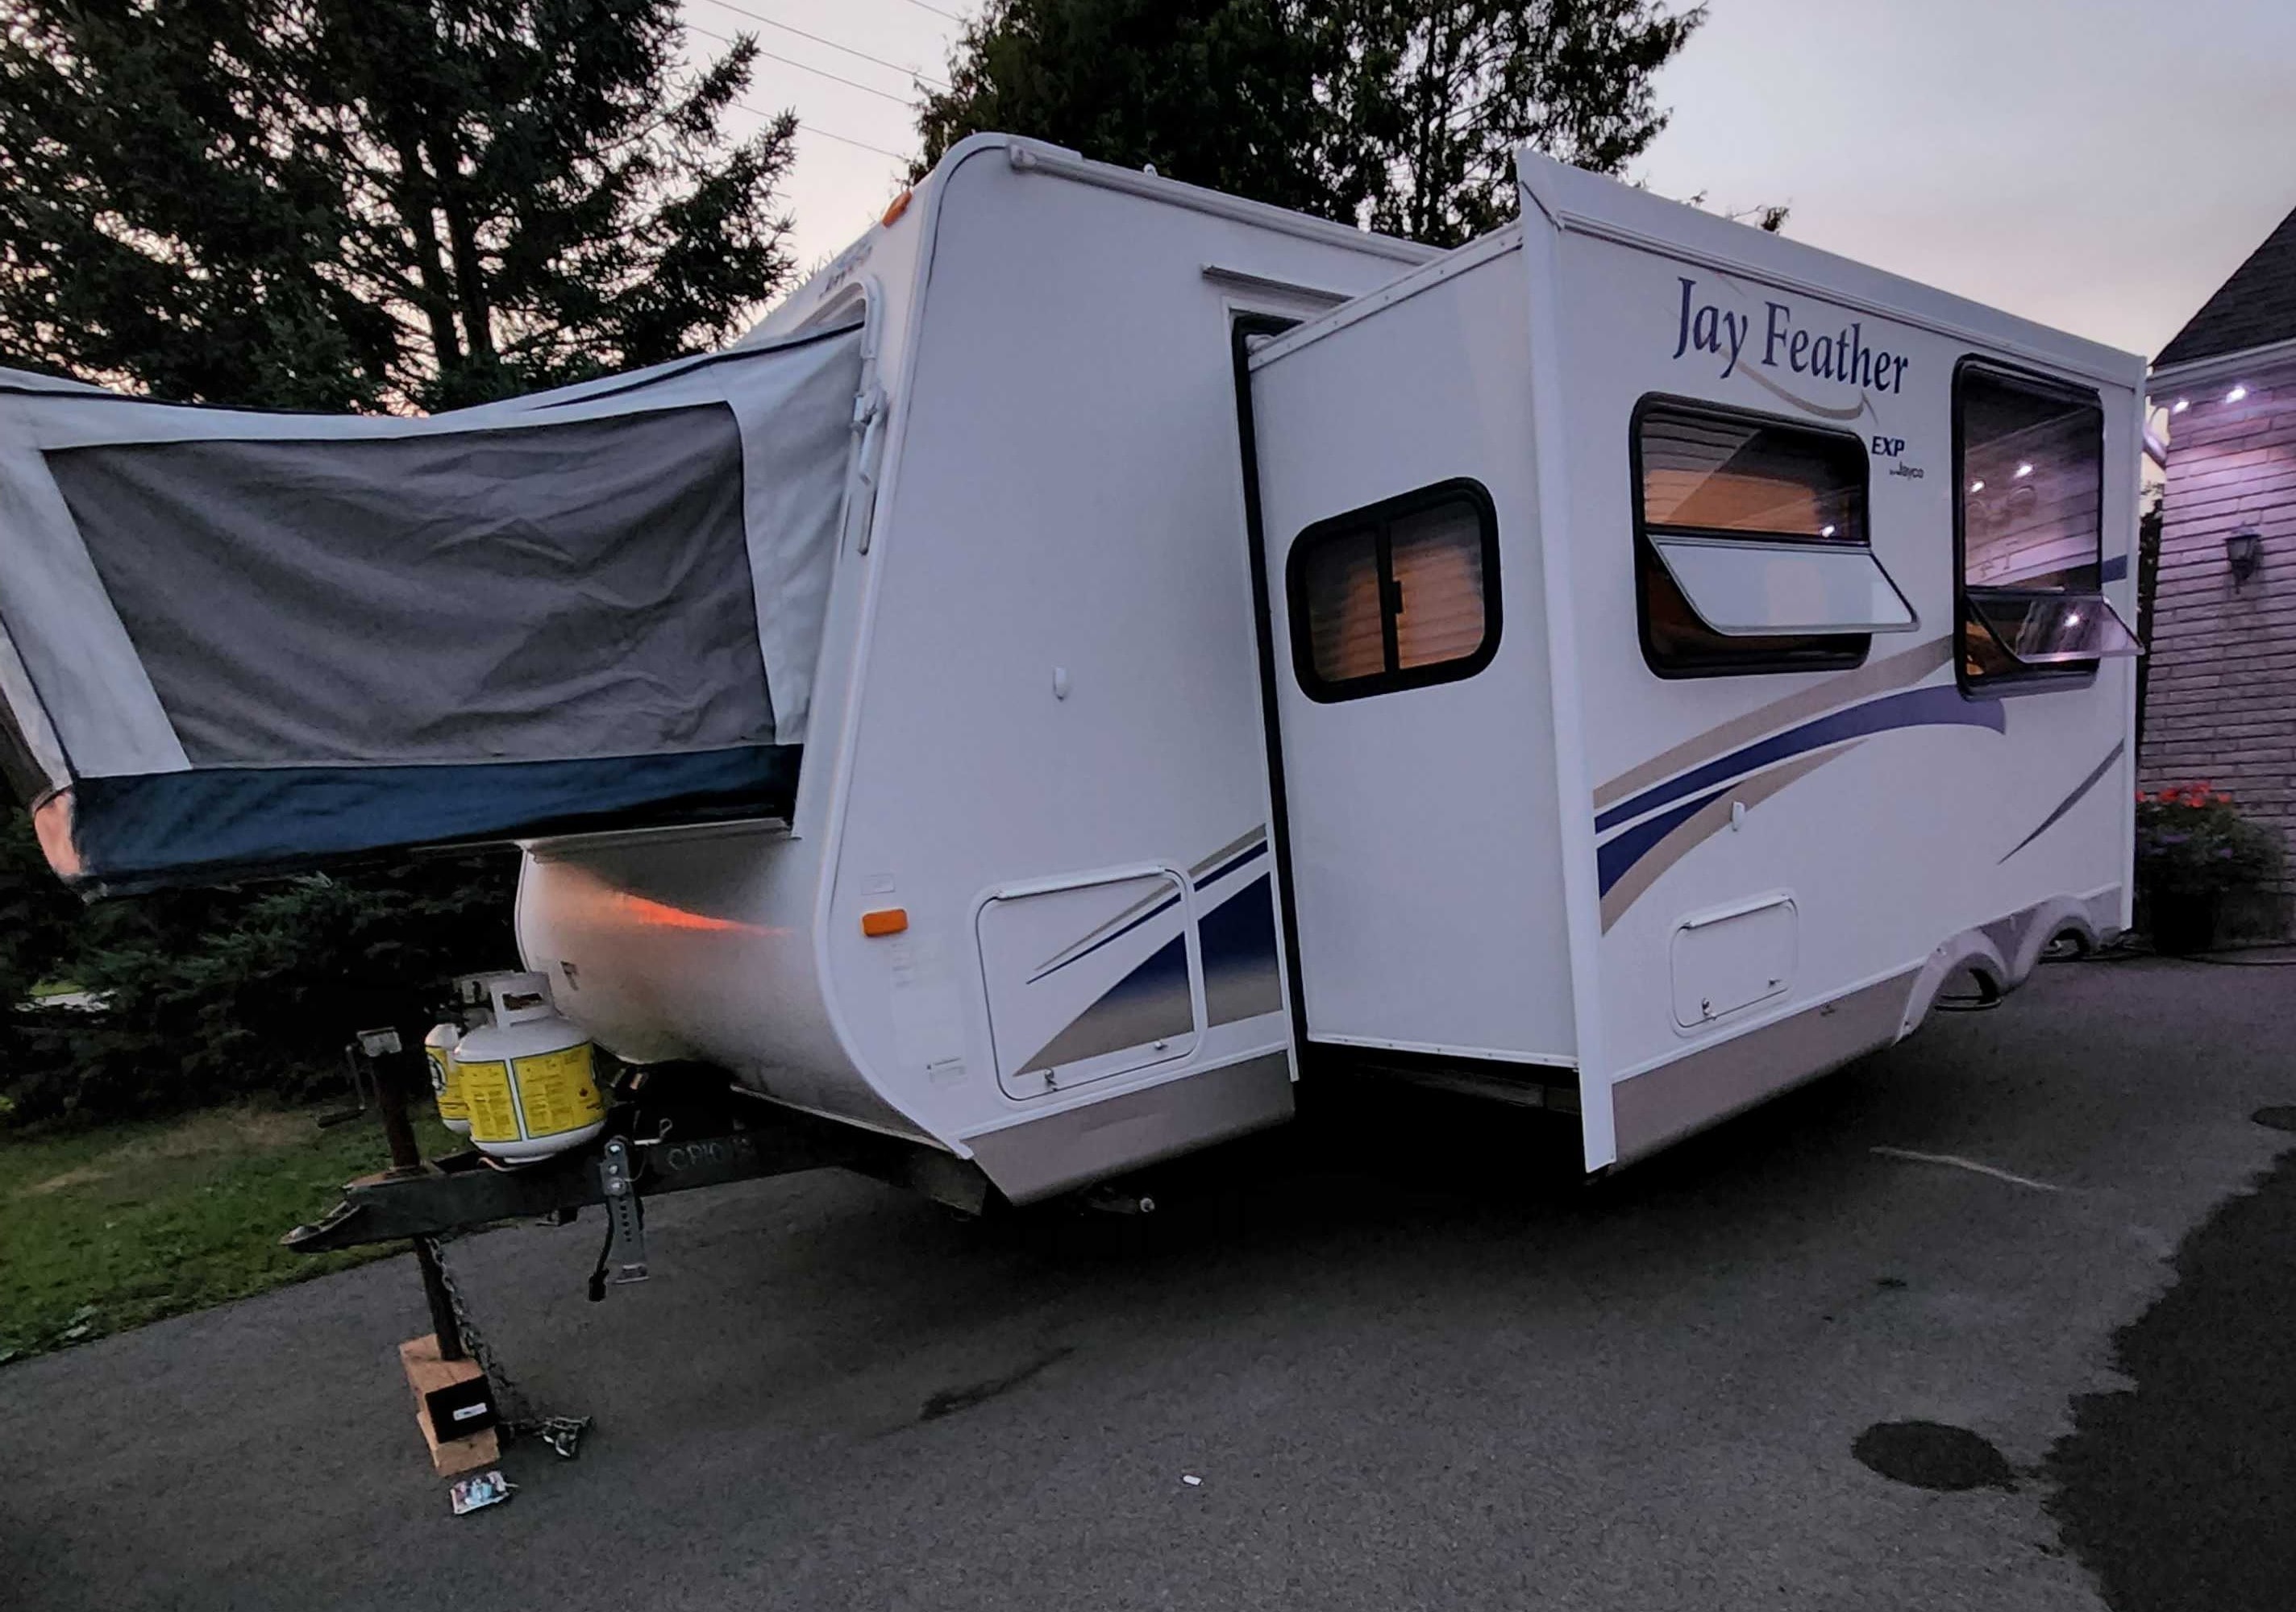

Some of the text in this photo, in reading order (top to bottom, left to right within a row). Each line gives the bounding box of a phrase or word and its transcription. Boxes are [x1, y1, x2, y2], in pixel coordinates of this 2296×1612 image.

[1673, 276, 1909, 394] Jay Feather
[1871, 435, 1906, 457] EXP
